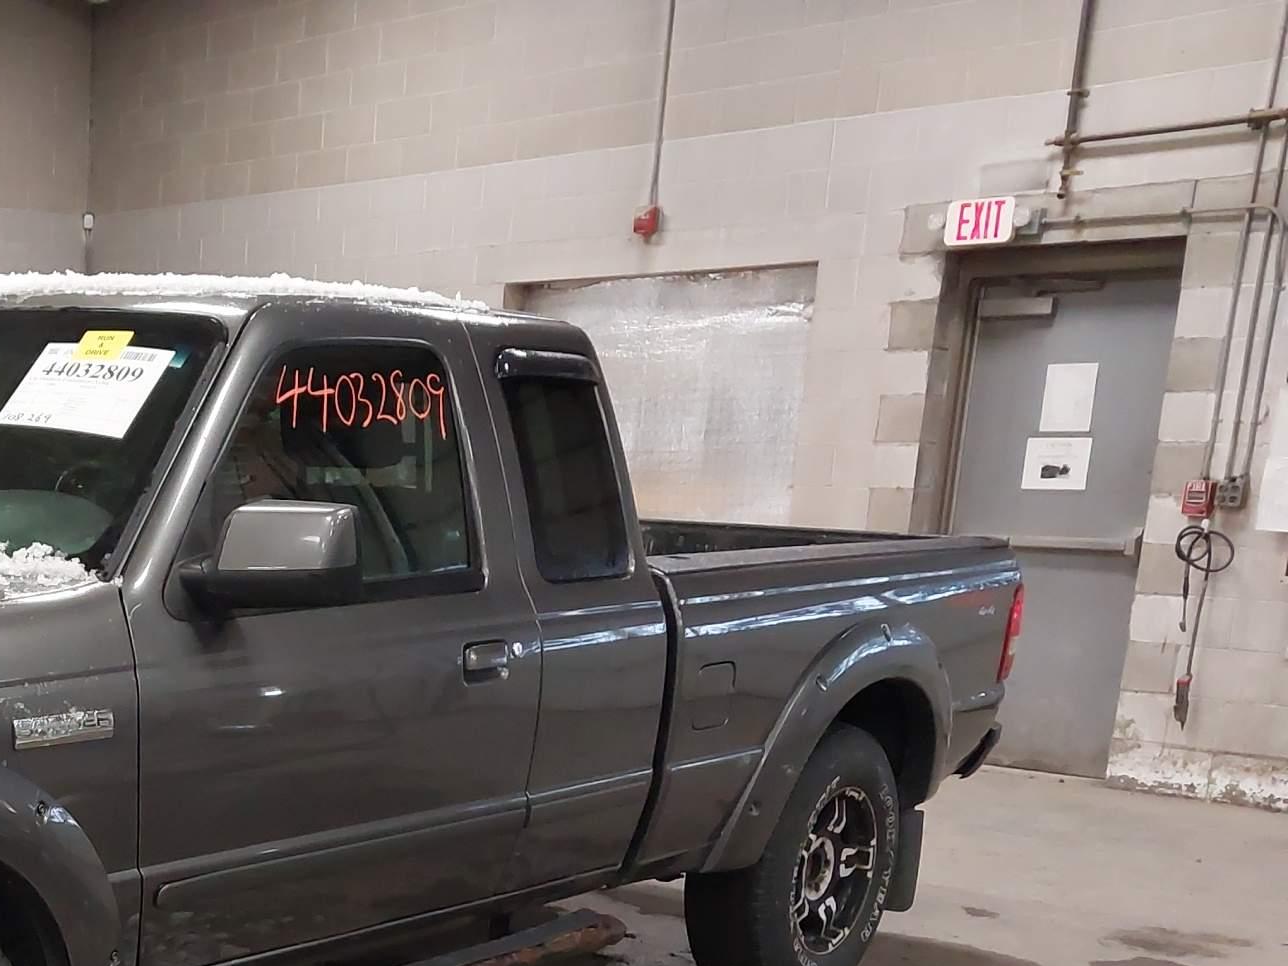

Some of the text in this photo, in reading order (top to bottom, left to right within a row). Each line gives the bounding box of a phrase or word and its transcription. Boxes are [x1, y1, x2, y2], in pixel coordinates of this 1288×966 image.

[956, 200, 1006, 241] EXIT
[42, 361, 144, 383] 44032809
[276, 364, 447, 440] 44032809
